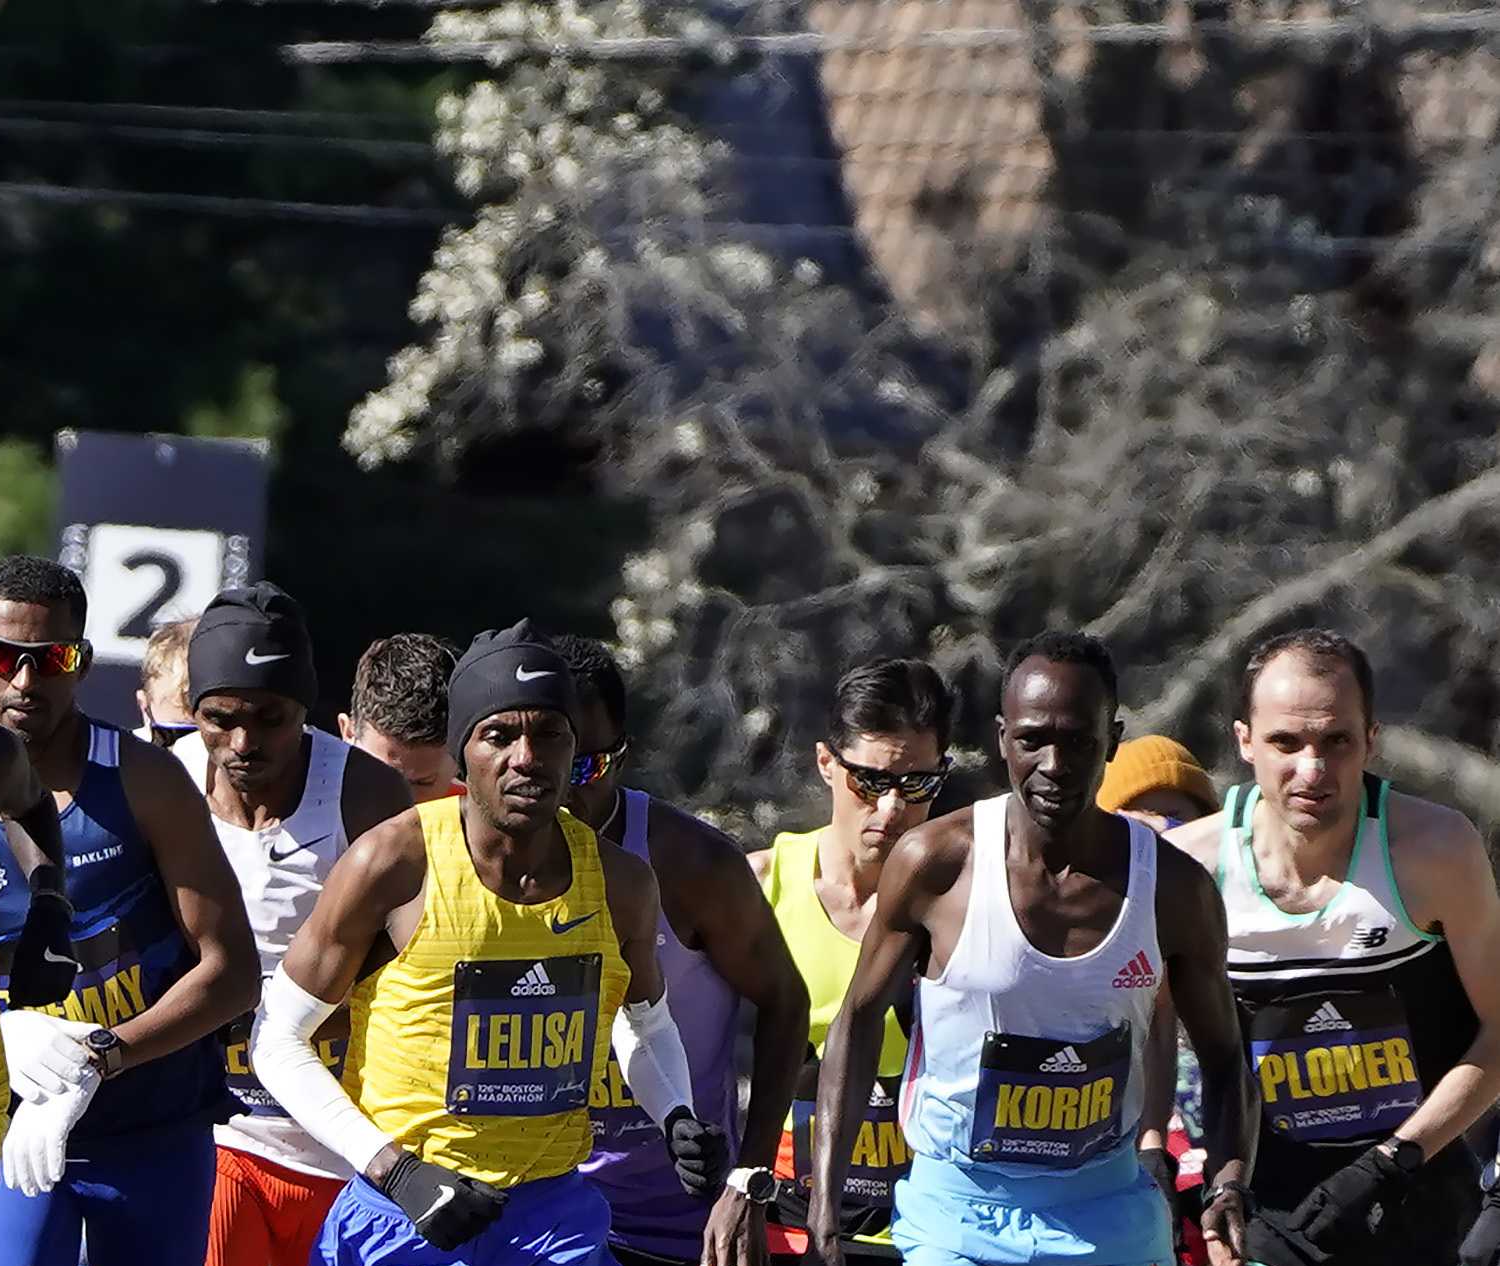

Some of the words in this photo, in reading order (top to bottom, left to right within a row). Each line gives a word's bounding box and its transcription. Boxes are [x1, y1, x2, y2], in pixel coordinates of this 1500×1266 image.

[116, 548, 183, 639] 2
[465, 1010, 585, 1069] LELISA
[477, 1093, 545, 1103] MARATHON
[502, 1084, 544, 1094] BOSTON
[1259, 1038, 1417, 1103] PLONER
[994, 1077, 1114, 1130] KORIR
